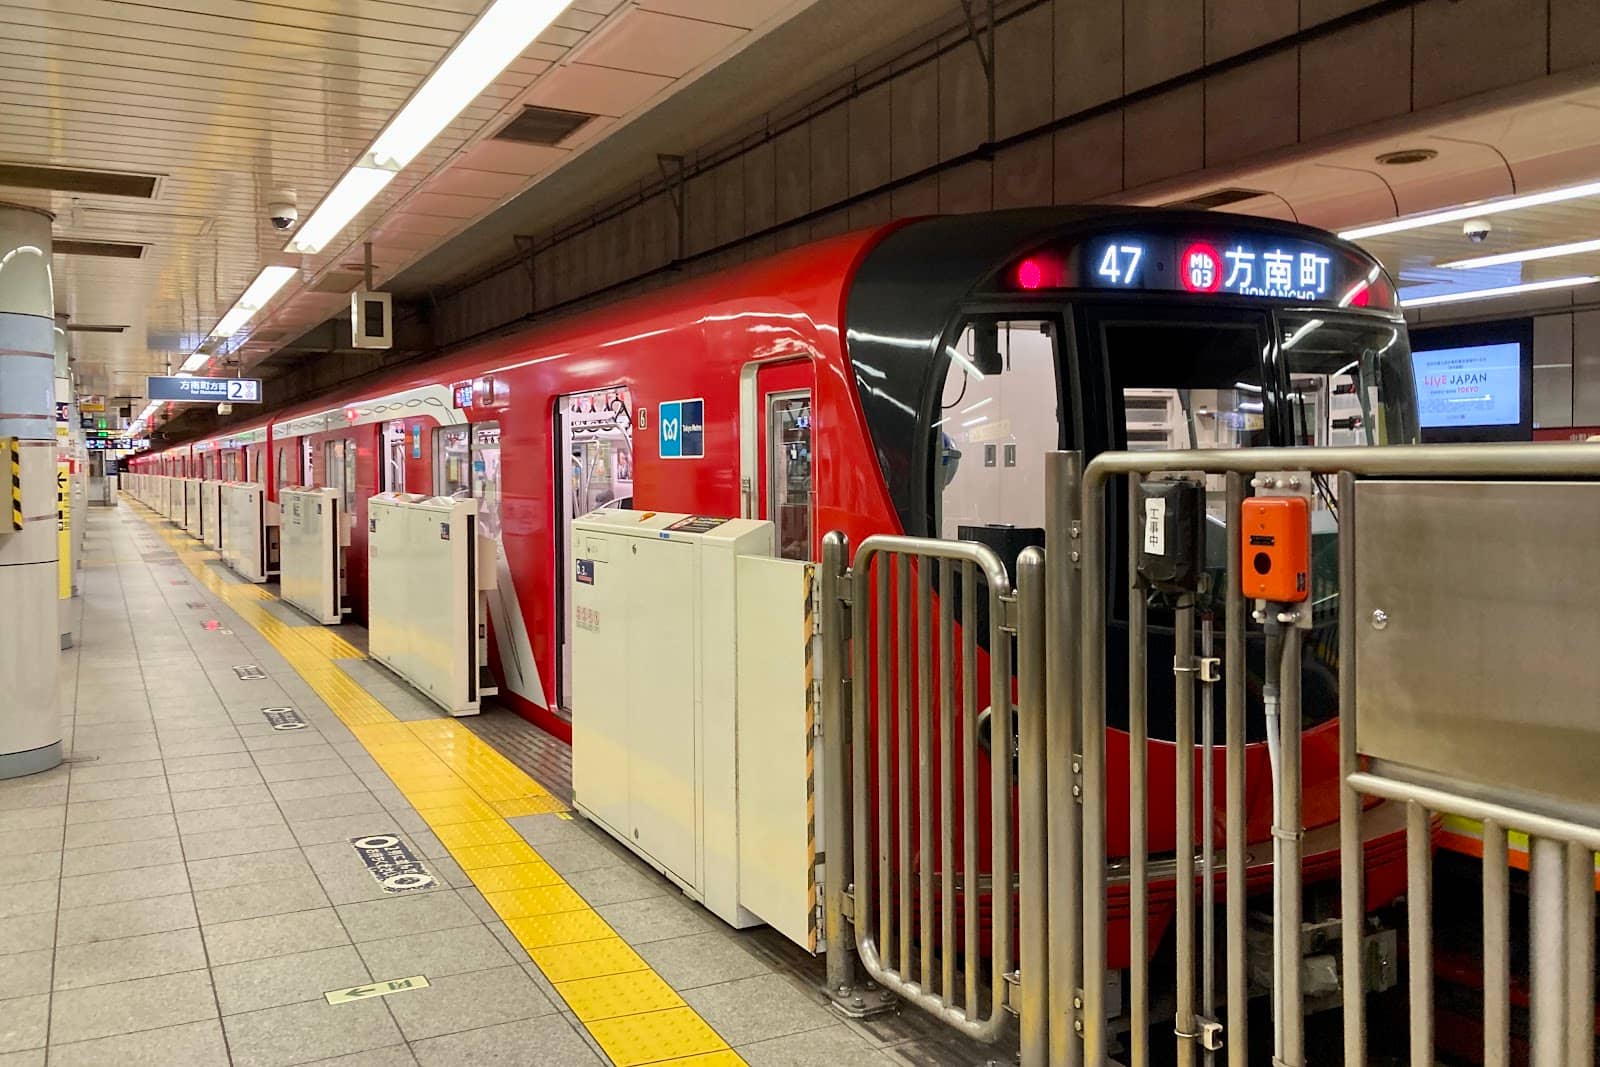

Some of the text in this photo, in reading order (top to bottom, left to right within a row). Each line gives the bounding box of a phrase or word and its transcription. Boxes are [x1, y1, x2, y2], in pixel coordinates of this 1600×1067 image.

[1099, 245, 1141, 284] 47
[1190, 254, 1213, 269] Mb
[1225, 246, 1330, 293] 方南町
[1191, 270, 1213, 287] 03
[1424, 372, 1487, 387] LIVE JAPAN
[231, 382, 243, 398] 2
[1457, 385, 1479, 393] TOKYO
[640, 410, 646, 428] 6
